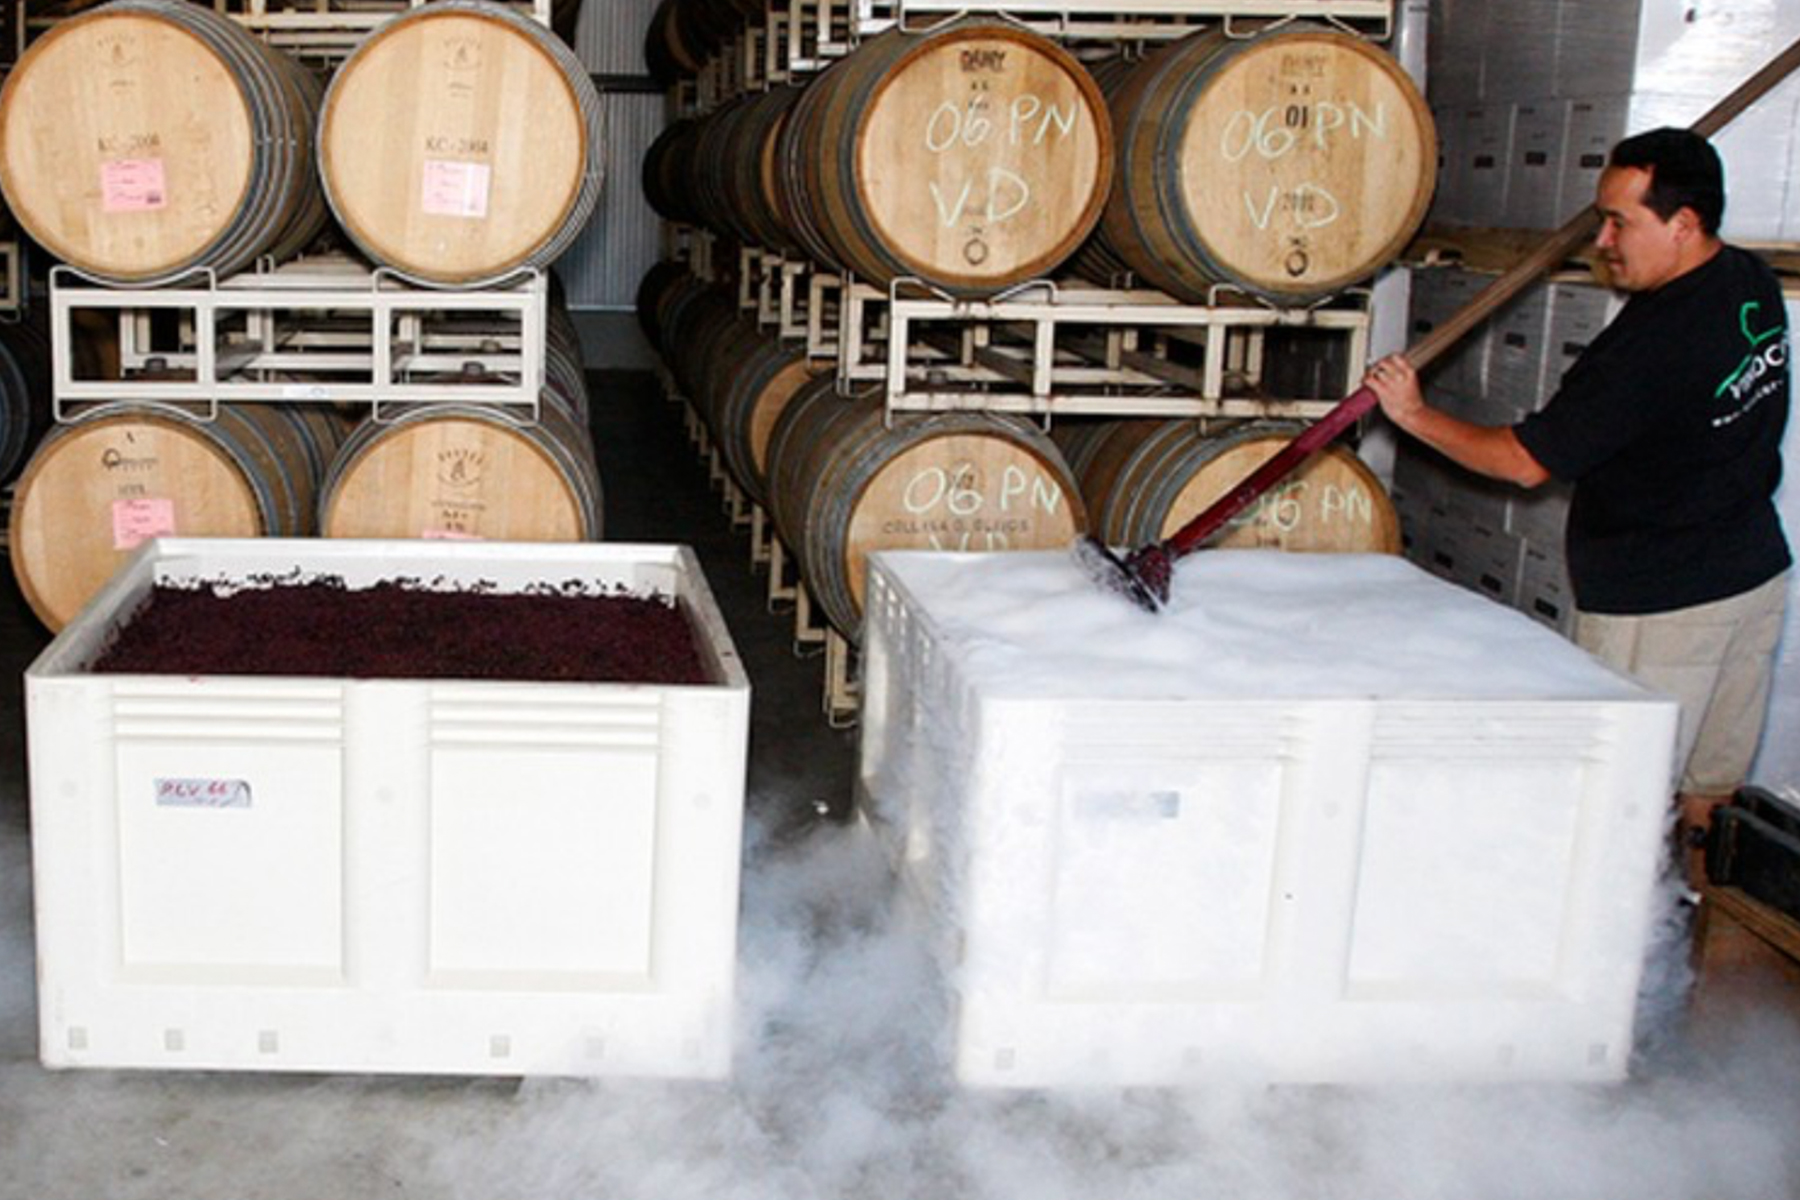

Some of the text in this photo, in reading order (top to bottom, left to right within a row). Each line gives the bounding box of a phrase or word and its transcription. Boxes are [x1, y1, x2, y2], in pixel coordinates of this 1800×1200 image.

[926, 93, 1077, 152] 06 PN
[1220, 100, 1387, 162] 06 PN
[903, 462, 1061, 515] 06 PN
